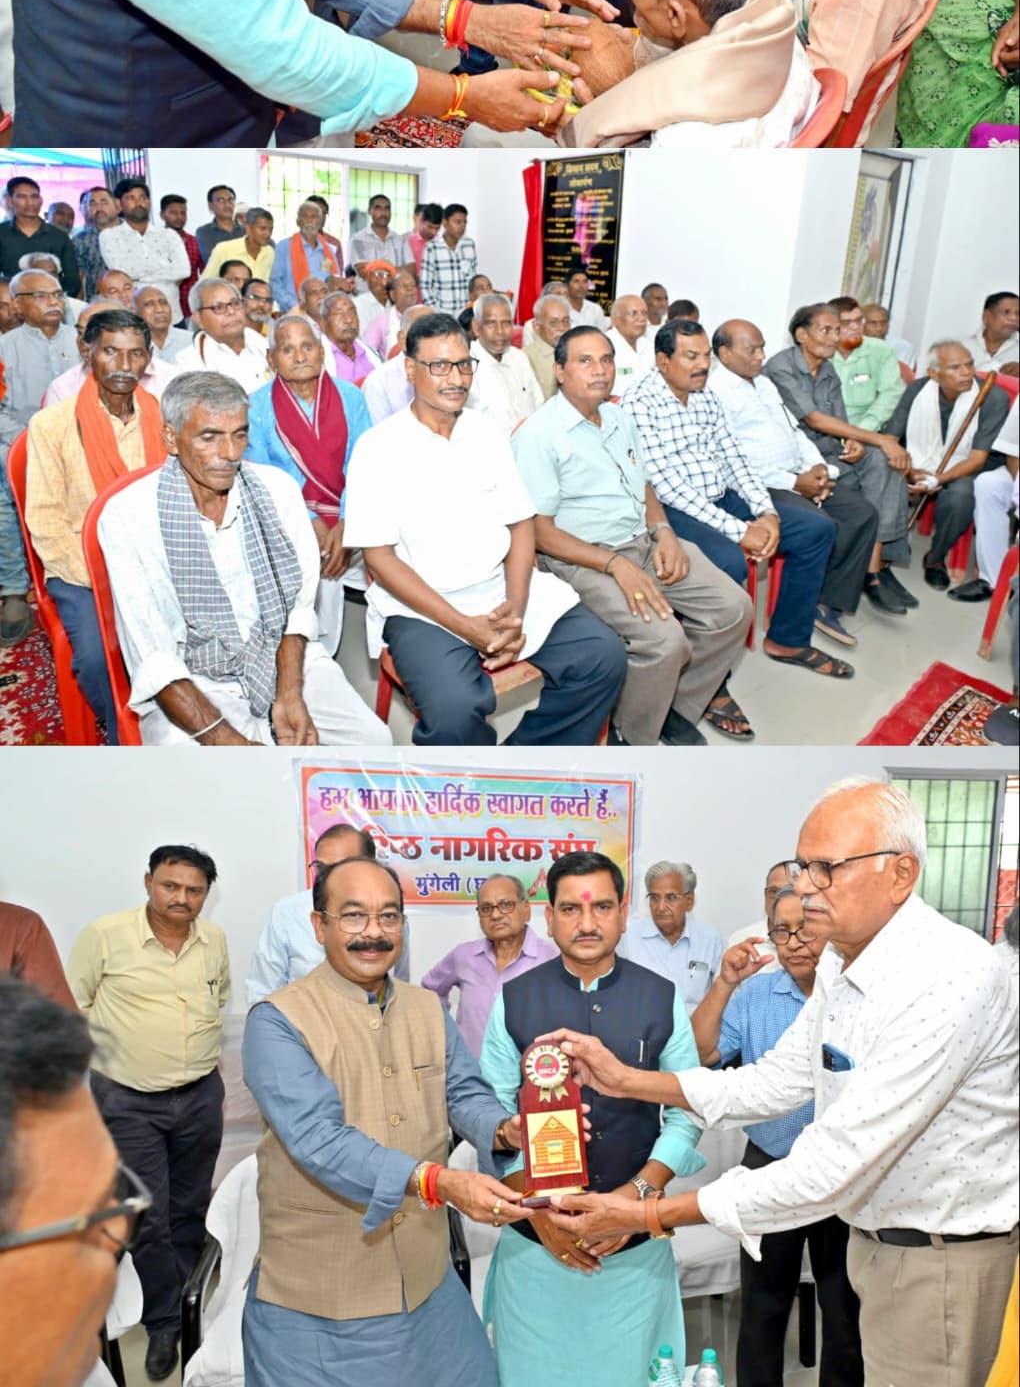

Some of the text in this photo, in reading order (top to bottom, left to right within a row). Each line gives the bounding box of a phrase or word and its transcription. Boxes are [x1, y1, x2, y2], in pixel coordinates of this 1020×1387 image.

[318, 786, 349, 812] हम
[358, 786, 419, 815] आपका
[425, 783, 481, 817] हार्दिक
[486, 792, 545, 817] स्वागत
[550, 788, 593, 819] करते
[430, 827, 544, 862] नागरिक
[416, 873, 461, 896] मुंगेली
